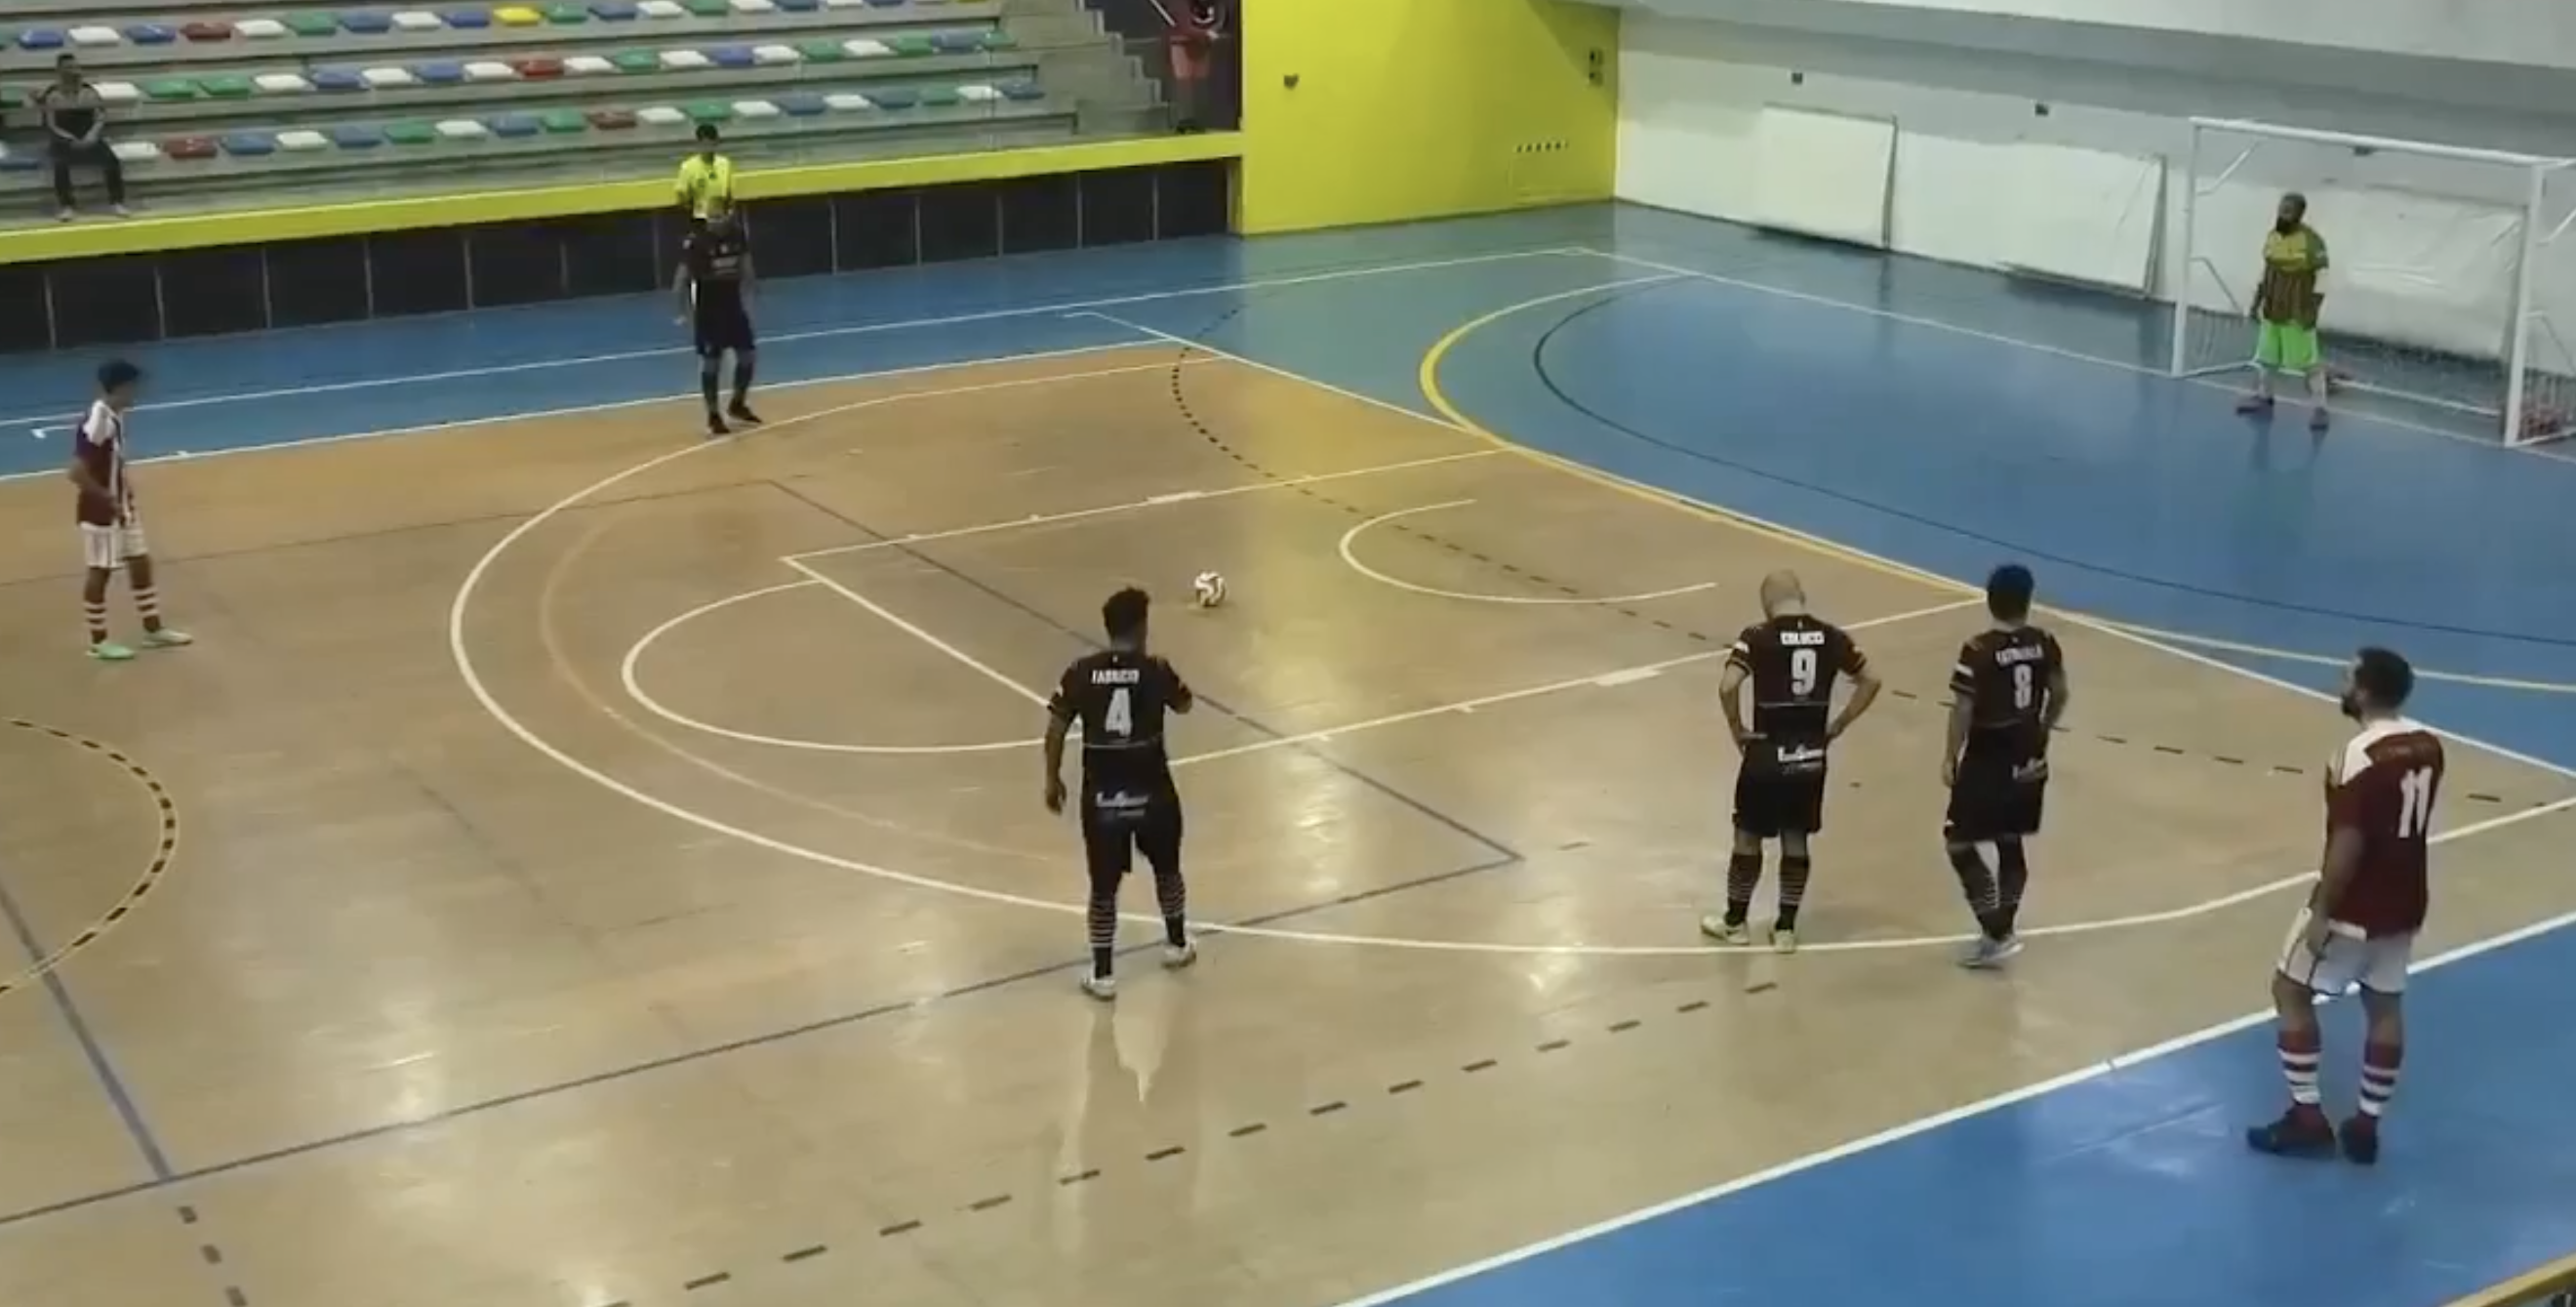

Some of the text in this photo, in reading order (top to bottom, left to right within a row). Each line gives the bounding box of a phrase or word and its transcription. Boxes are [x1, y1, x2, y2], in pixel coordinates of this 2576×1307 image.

[1791, 648, 1817, 695] 9
[2014, 664, 2033, 709] 8
[1105, 687, 1132, 736] 4
[2398, 765, 2433, 838] 11
